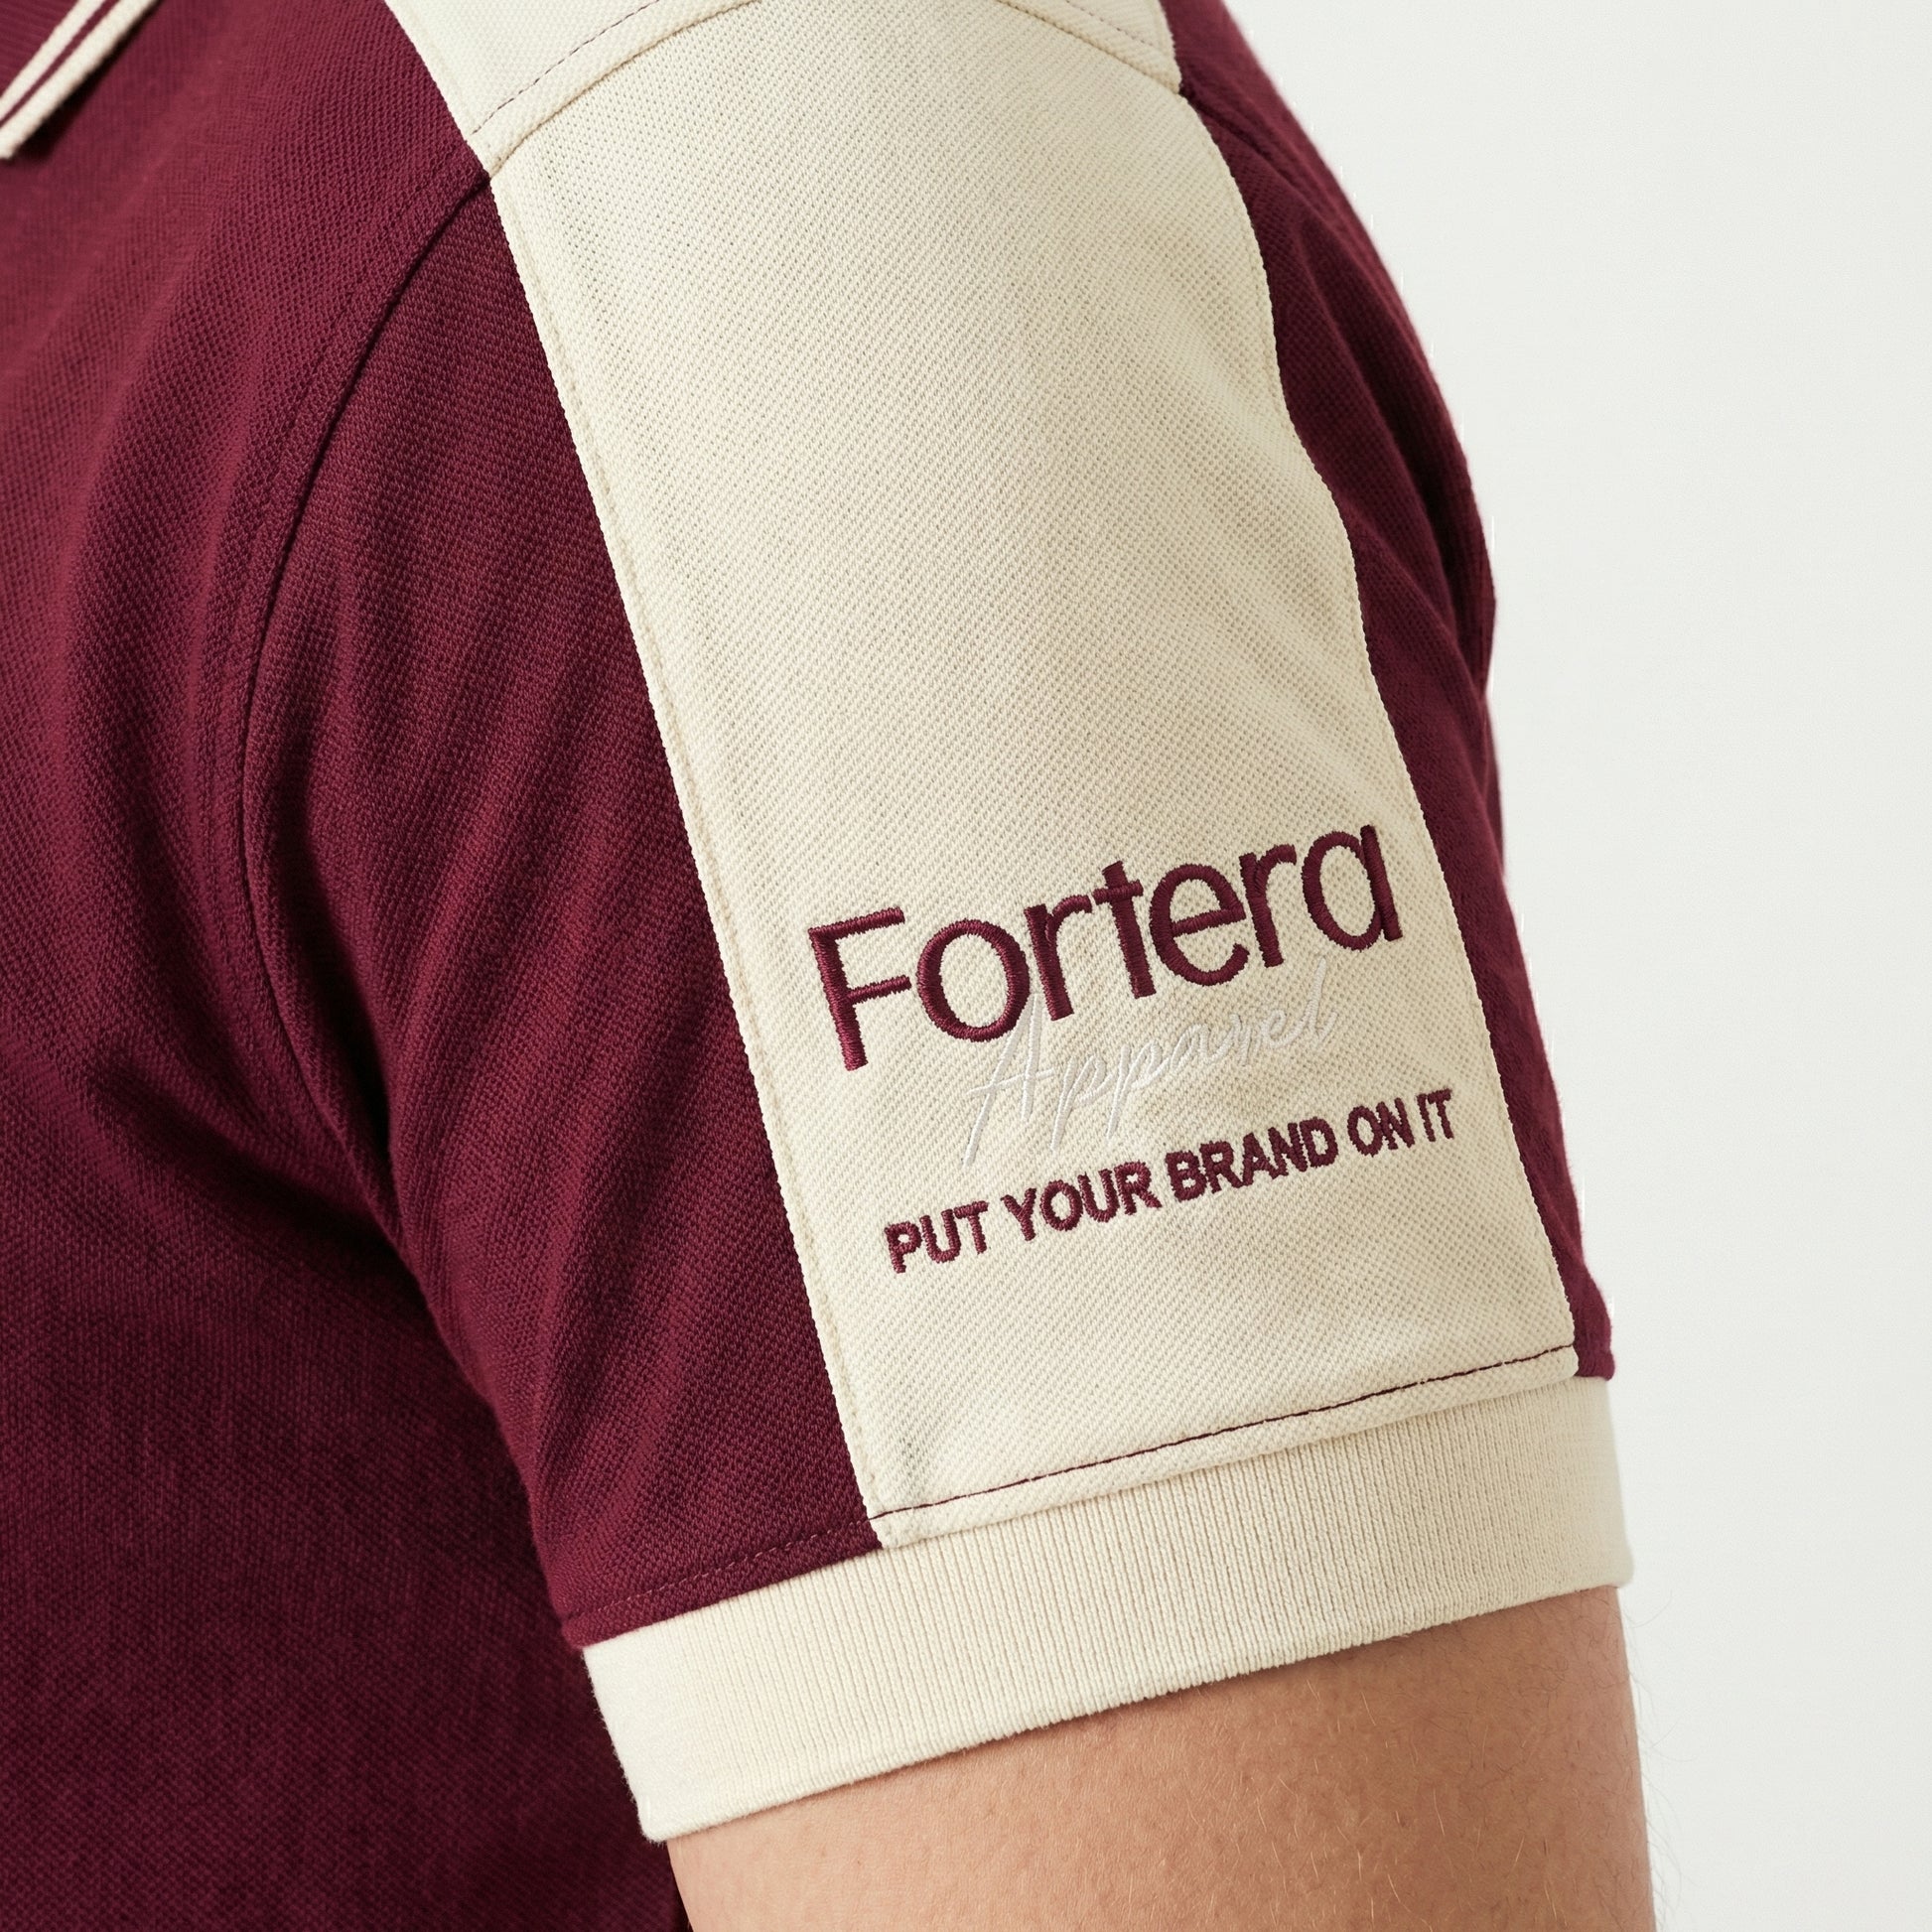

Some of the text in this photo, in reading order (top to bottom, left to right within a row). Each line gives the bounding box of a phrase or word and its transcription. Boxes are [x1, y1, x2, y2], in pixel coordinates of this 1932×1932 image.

[807, 823, 1404, 1072] Fortera
[959, 955, 1340, 1171] Apparel
[883, 1086, 1455, 1275] PUT YOUR BRAND ON IT
